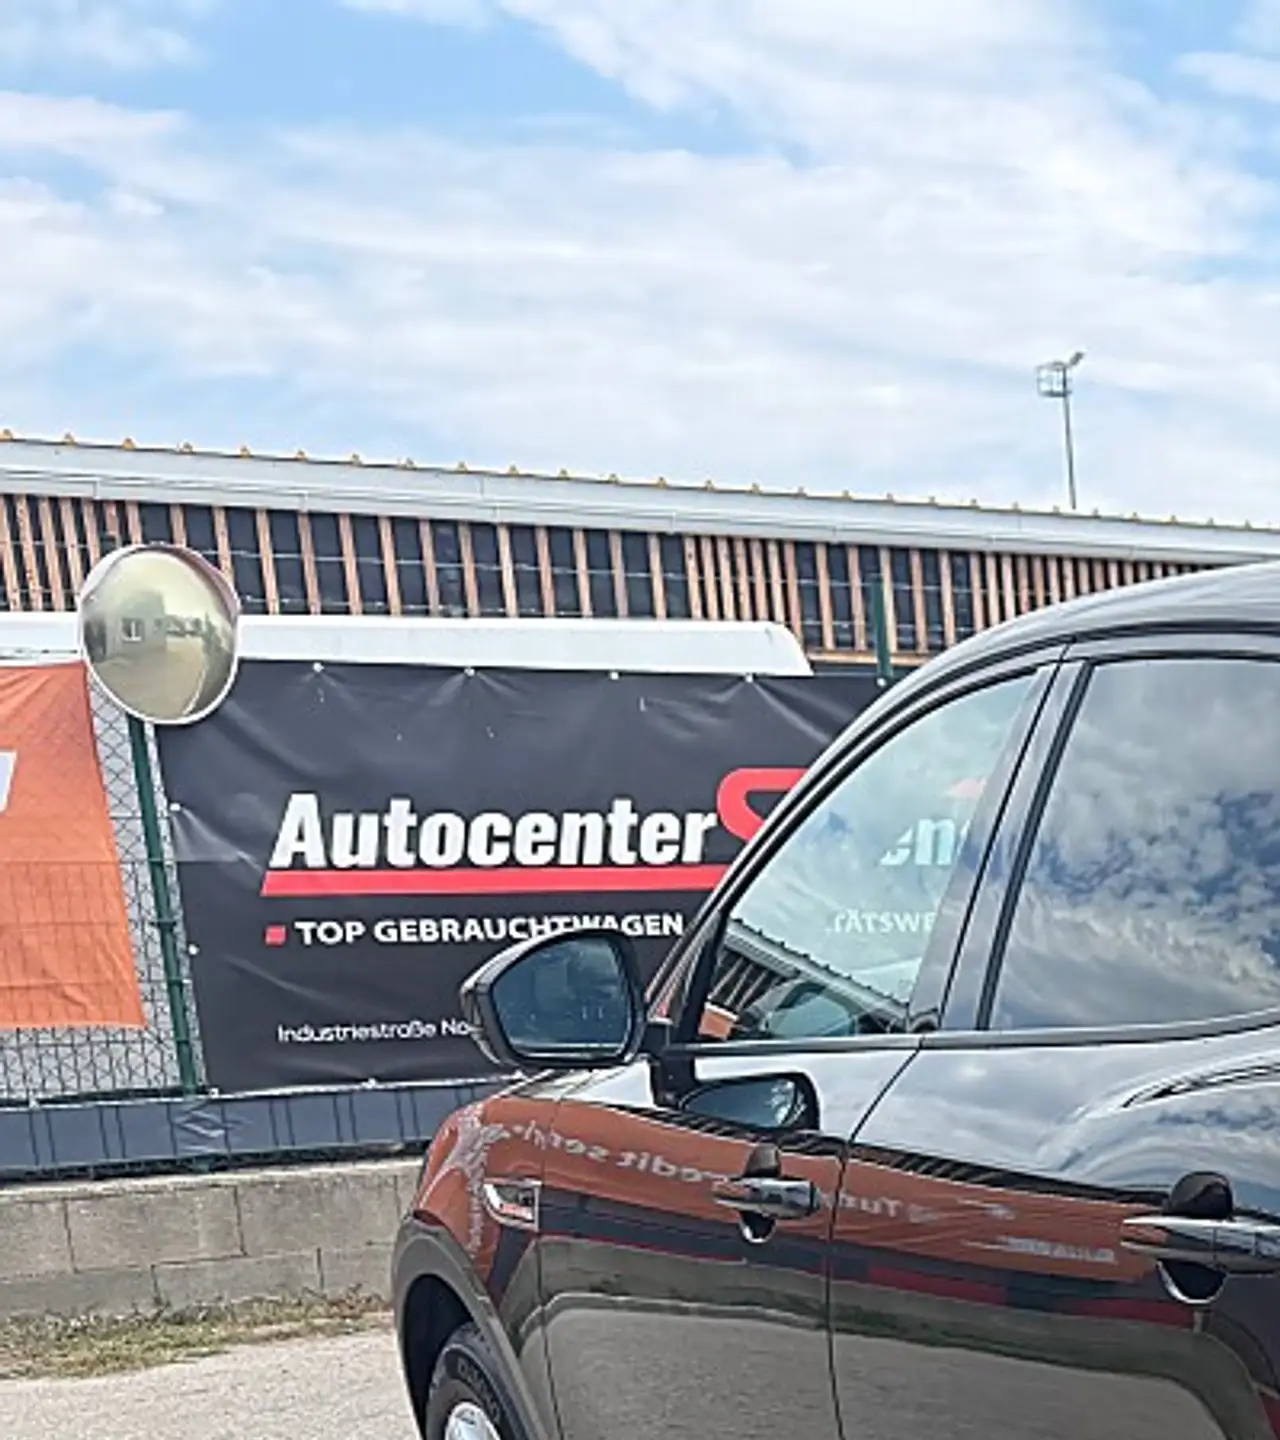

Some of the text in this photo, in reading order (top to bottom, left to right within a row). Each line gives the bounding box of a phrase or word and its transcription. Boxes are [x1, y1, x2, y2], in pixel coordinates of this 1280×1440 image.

[269, 794, 717, 867] Autocenter
[295, 920, 364, 945] TOP
[278, 1020, 437, 1042] Industriestraße
